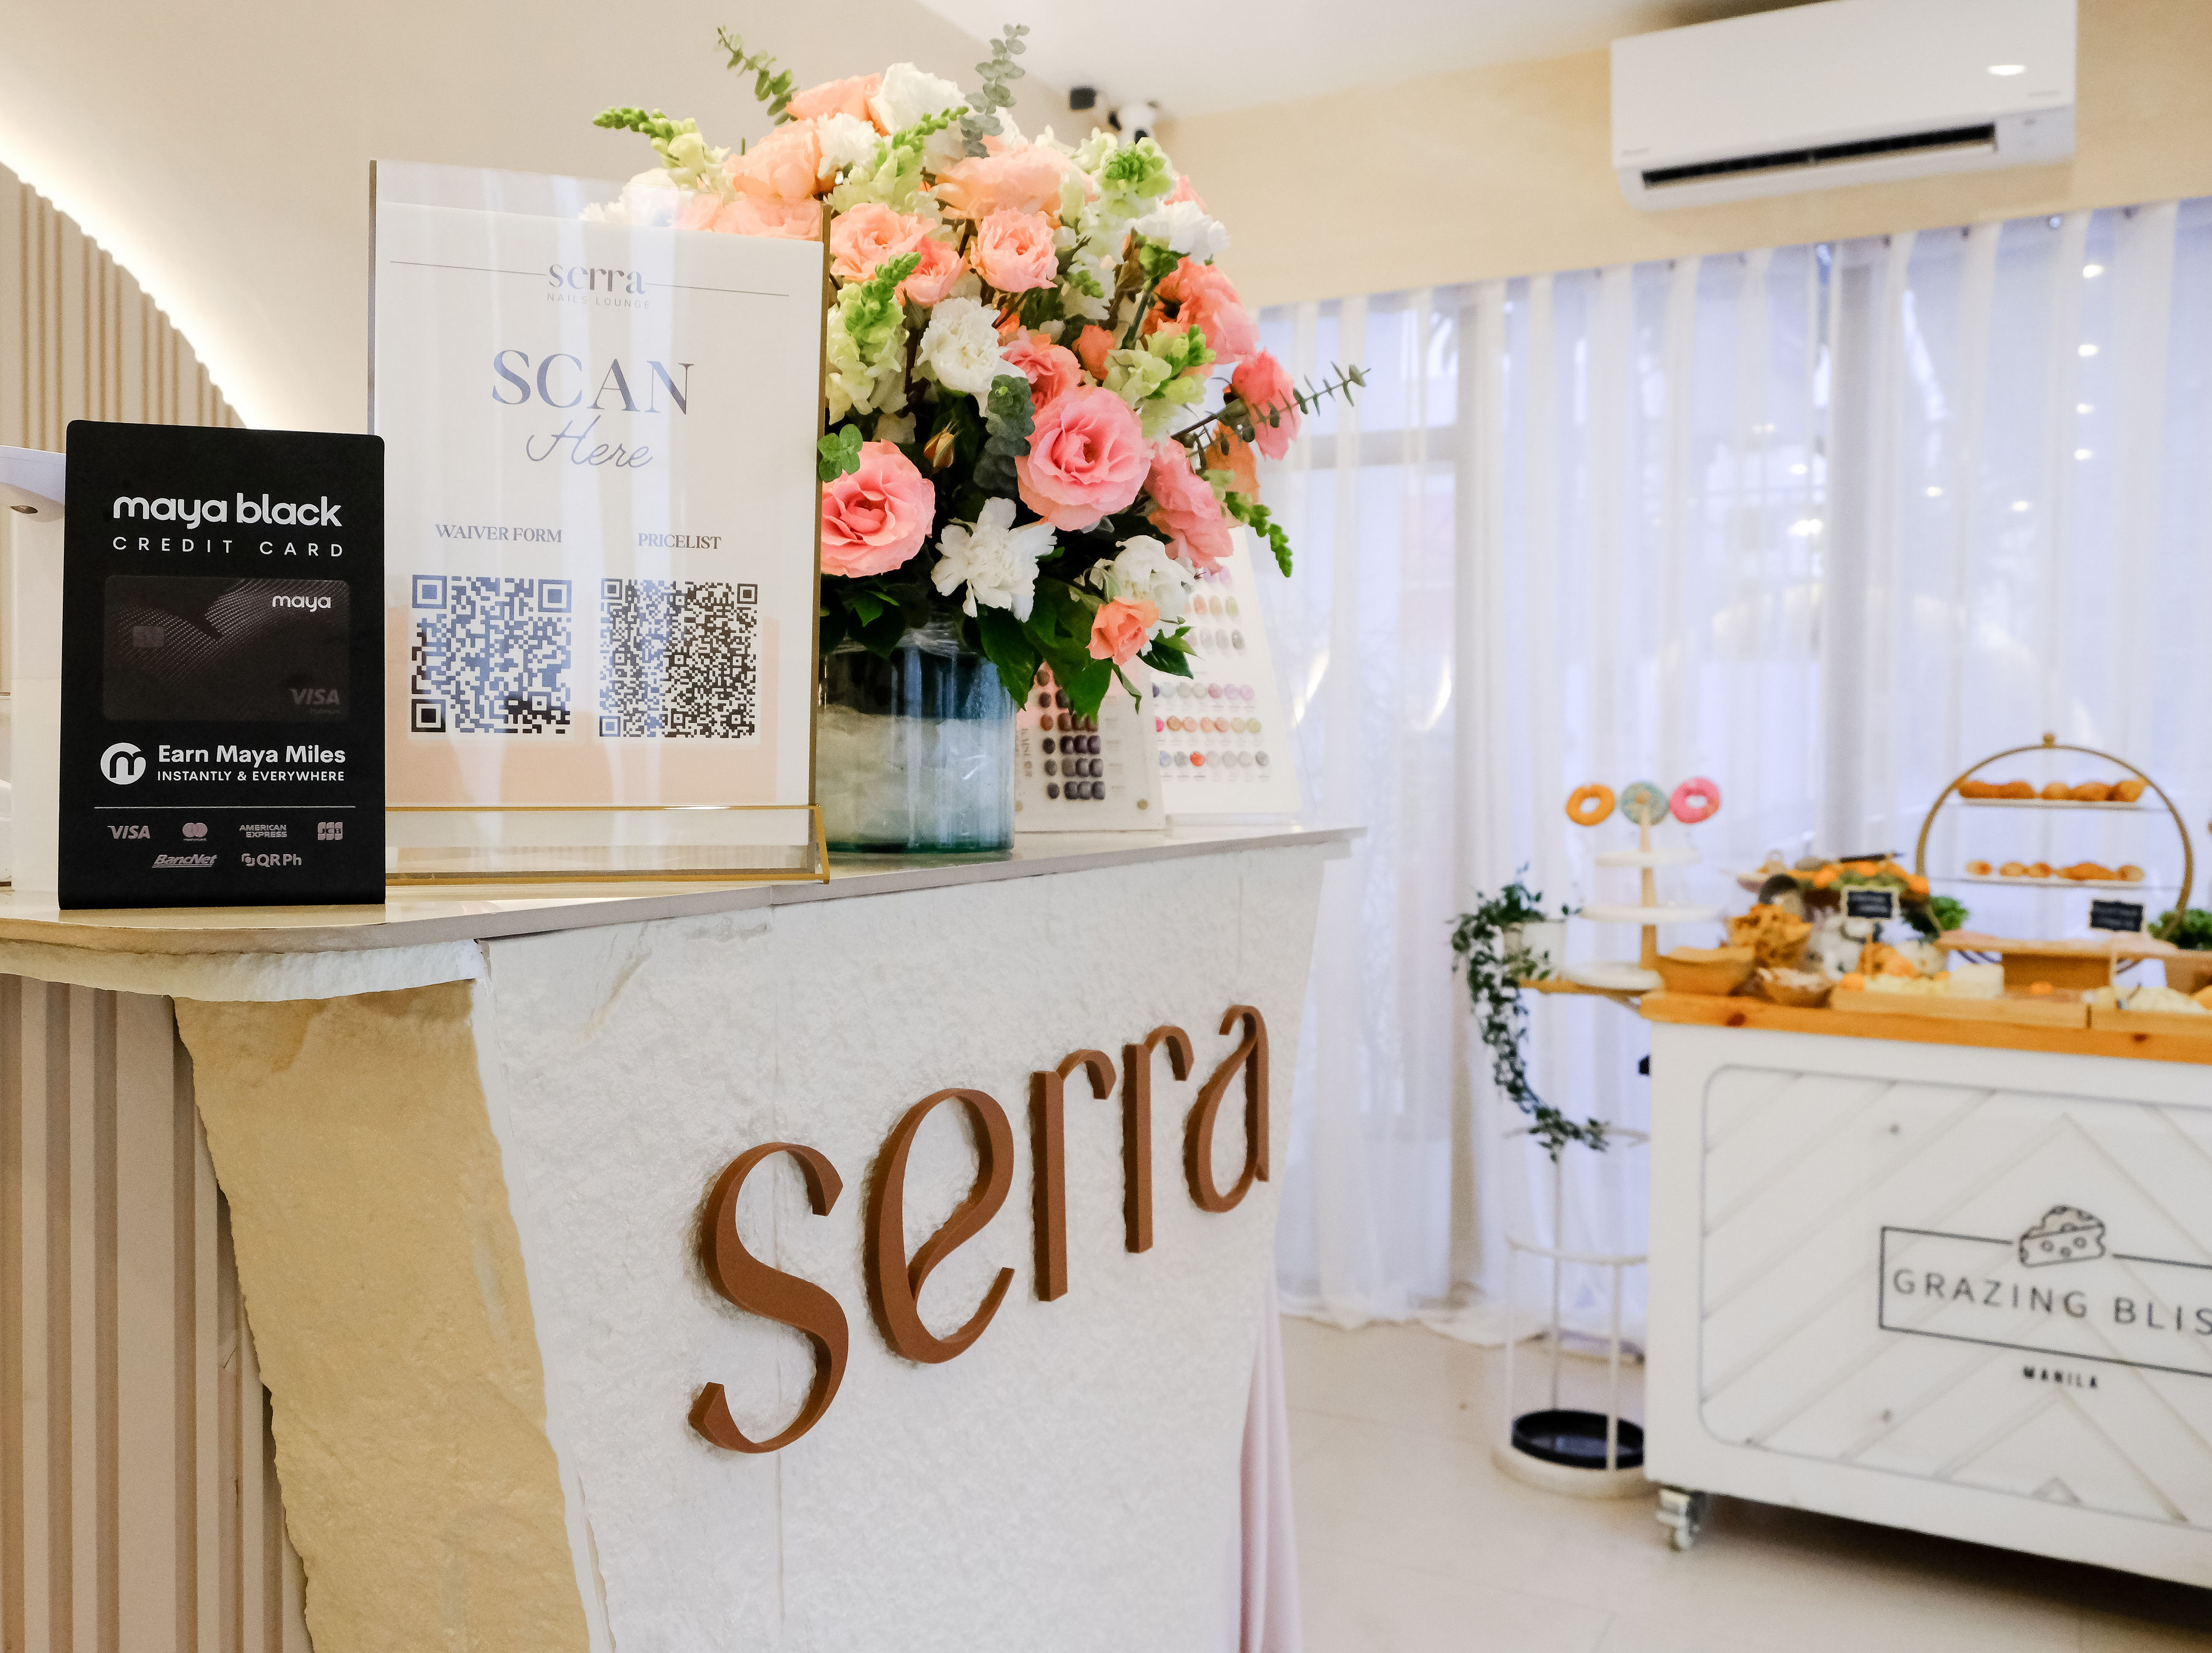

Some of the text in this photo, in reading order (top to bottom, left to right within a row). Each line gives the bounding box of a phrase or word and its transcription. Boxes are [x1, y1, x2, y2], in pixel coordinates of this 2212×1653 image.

[549, 264, 646, 294] serra
[547, 293, 650, 310] NAILS LOUNGE
[492, 350, 694, 415] SCAN
[526, 415, 654, 468] Here
[113, 492, 342, 529] maya black
[434, 524, 562, 543] WAIVER FORM
[638, 533, 722, 549] PRICELIST
[112, 536, 343, 557] CREDIT CARD
[272, 595, 331, 611] maya
[289, 688, 340, 705] VISA
[159, 745, 346, 768] Earn Maya Miles
[158, 771, 344, 781] INSTANTLY & EVERYWHERE
[108, 825, 151, 839] VISA
[317, 822, 343, 841] JCB
[155, 854, 218, 866] BancNet
[256, 854, 302, 868] QR Ph
[688, 1005, 1269, 1453] serra
[1892, 1268, 2088, 1319] GRAZING
